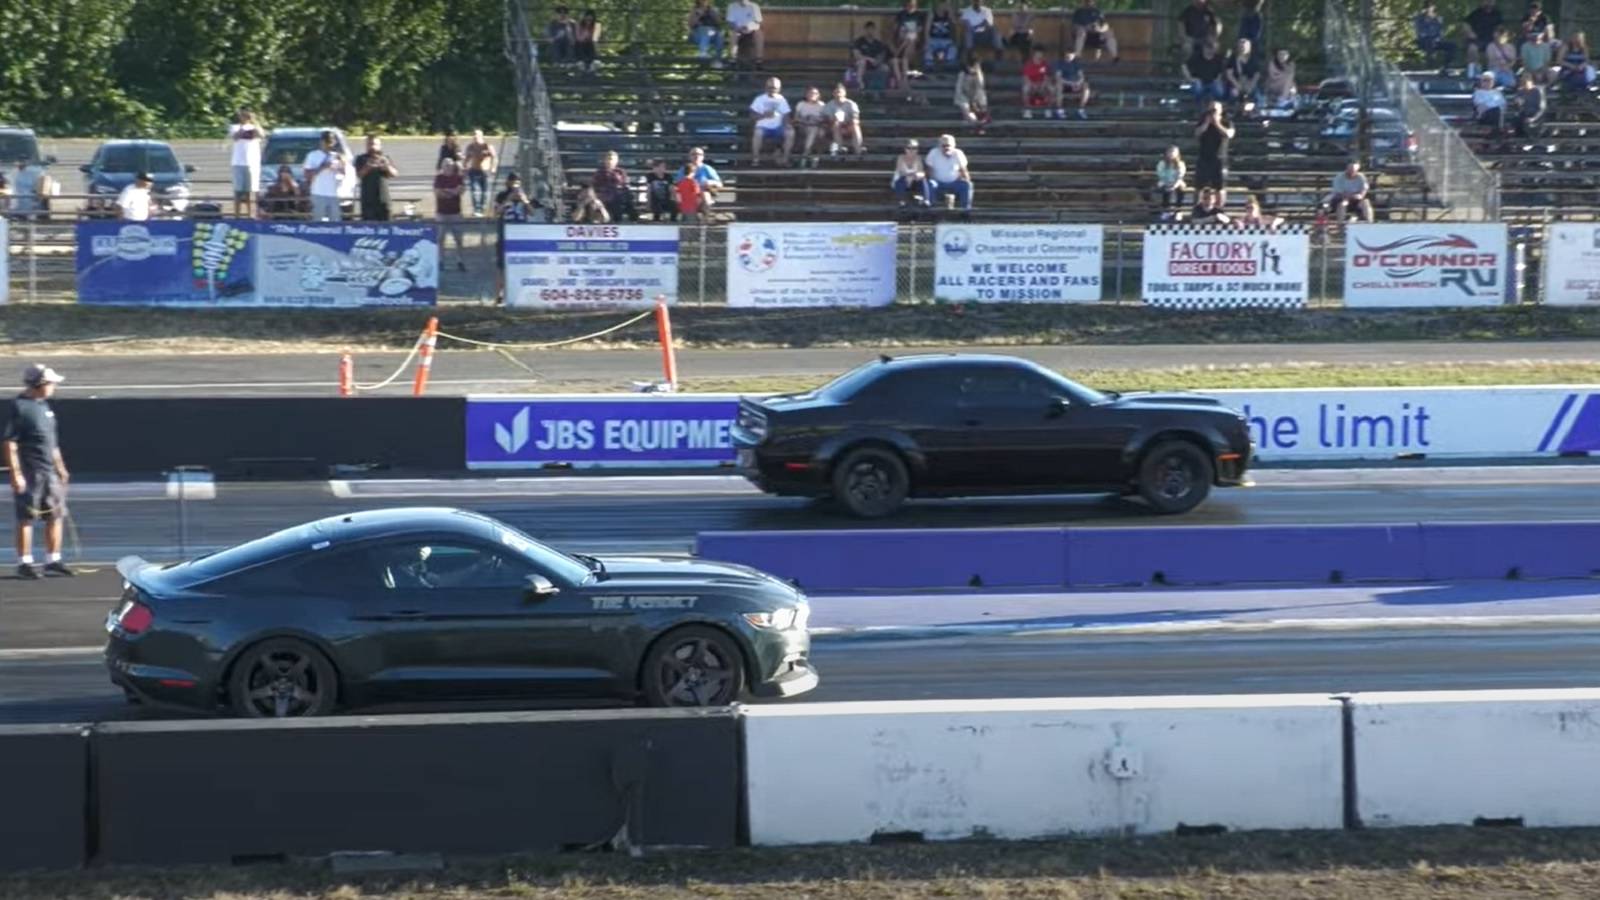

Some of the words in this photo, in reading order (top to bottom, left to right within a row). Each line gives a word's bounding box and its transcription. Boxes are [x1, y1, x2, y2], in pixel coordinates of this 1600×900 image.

[566, 226, 619, 238] DAVIES
[991, 229, 1035, 238] Mission
[1037, 229, 1087, 240] Regional
[975, 243, 1025, 254] Chamber
[1028, 243, 1038, 253] of
[1040, 244, 1099, 254] Commerce
[1170, 242, 1257, 259] FACTORY
[1352, 253, 1498, 268] O'CONNOR
[971, 263, 992, 273] WE
[997, 263, 1068, 273] WELCOME
[1171, 262, 1213, 274] DIRECT
[1215, 262, 1256, 274] TOOLS
[937, 276, 963, 286] ALL
[968, 276, 1026, 286] RACERS
[1029, 276, 1060, 286] AND
[1063, 276, 1099, 286] FANS
[1216, 283, 1223, 292] &
[1242, 282, 1271, 292] MUCH
[1274, 282, 1303, 292] MORE
[1439, 269, 1498, 297] RV
[540, 289, 644, 301] 604-826-6736
[976, 288, 995, 298] TO
[999, 288, 1062, 298] MISSION
[1319, 403, 1430, 448] limit
[535, 419, 596, 450] JBS
[591, 596, 625, 609] THE
